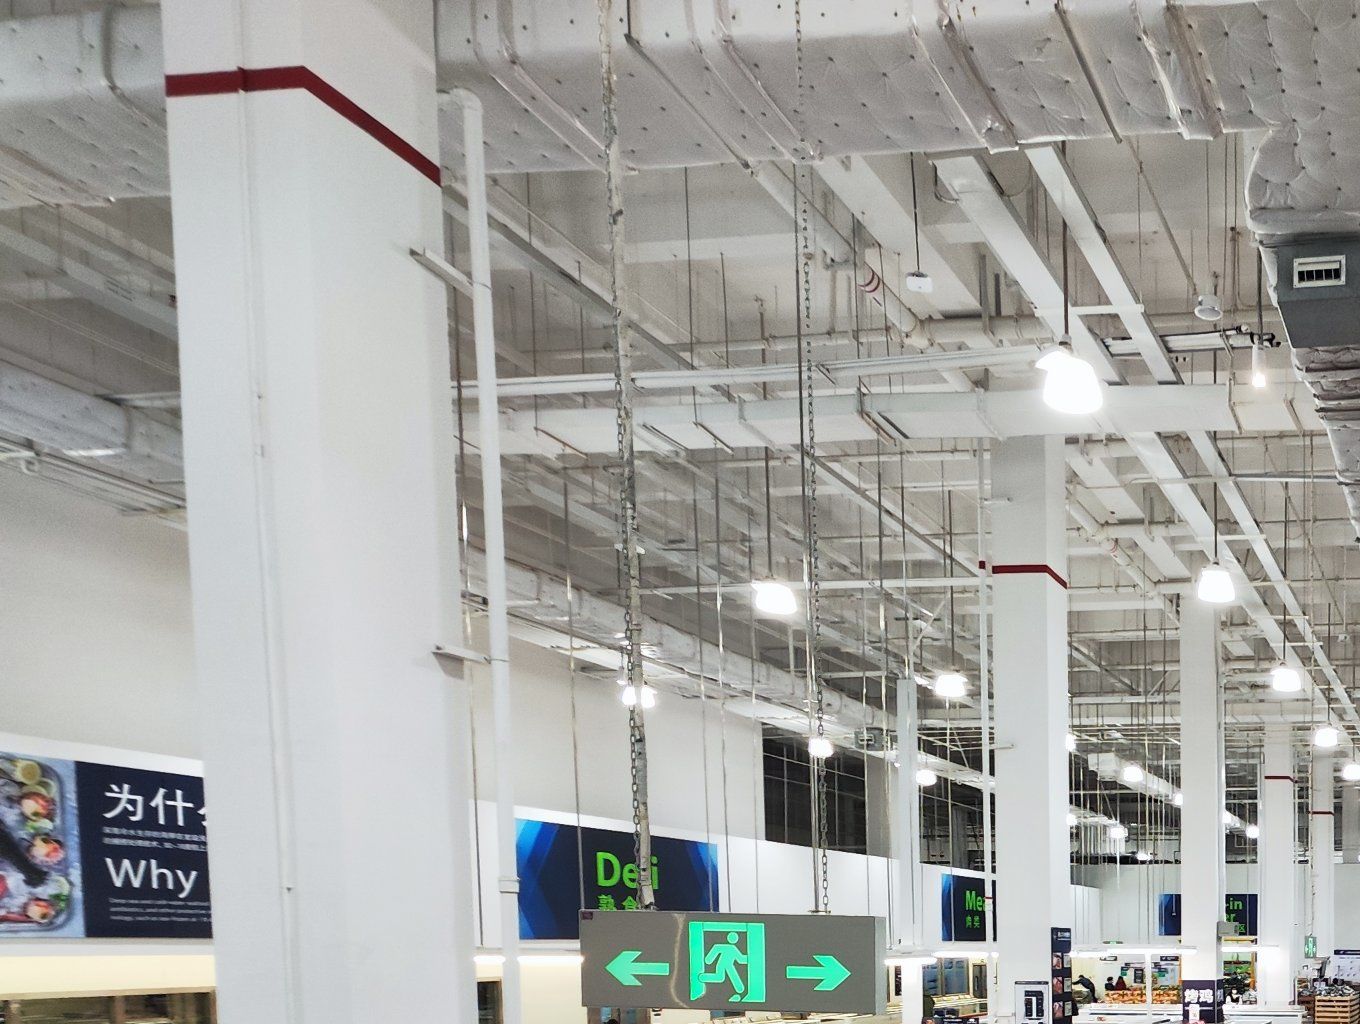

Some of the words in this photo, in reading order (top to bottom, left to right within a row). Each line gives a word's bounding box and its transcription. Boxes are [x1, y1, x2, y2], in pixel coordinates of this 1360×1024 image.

[102, 782, 207, 827] 为什
[104, 857, 199, 899] Why
[596, 851, 659, 890] Dei
